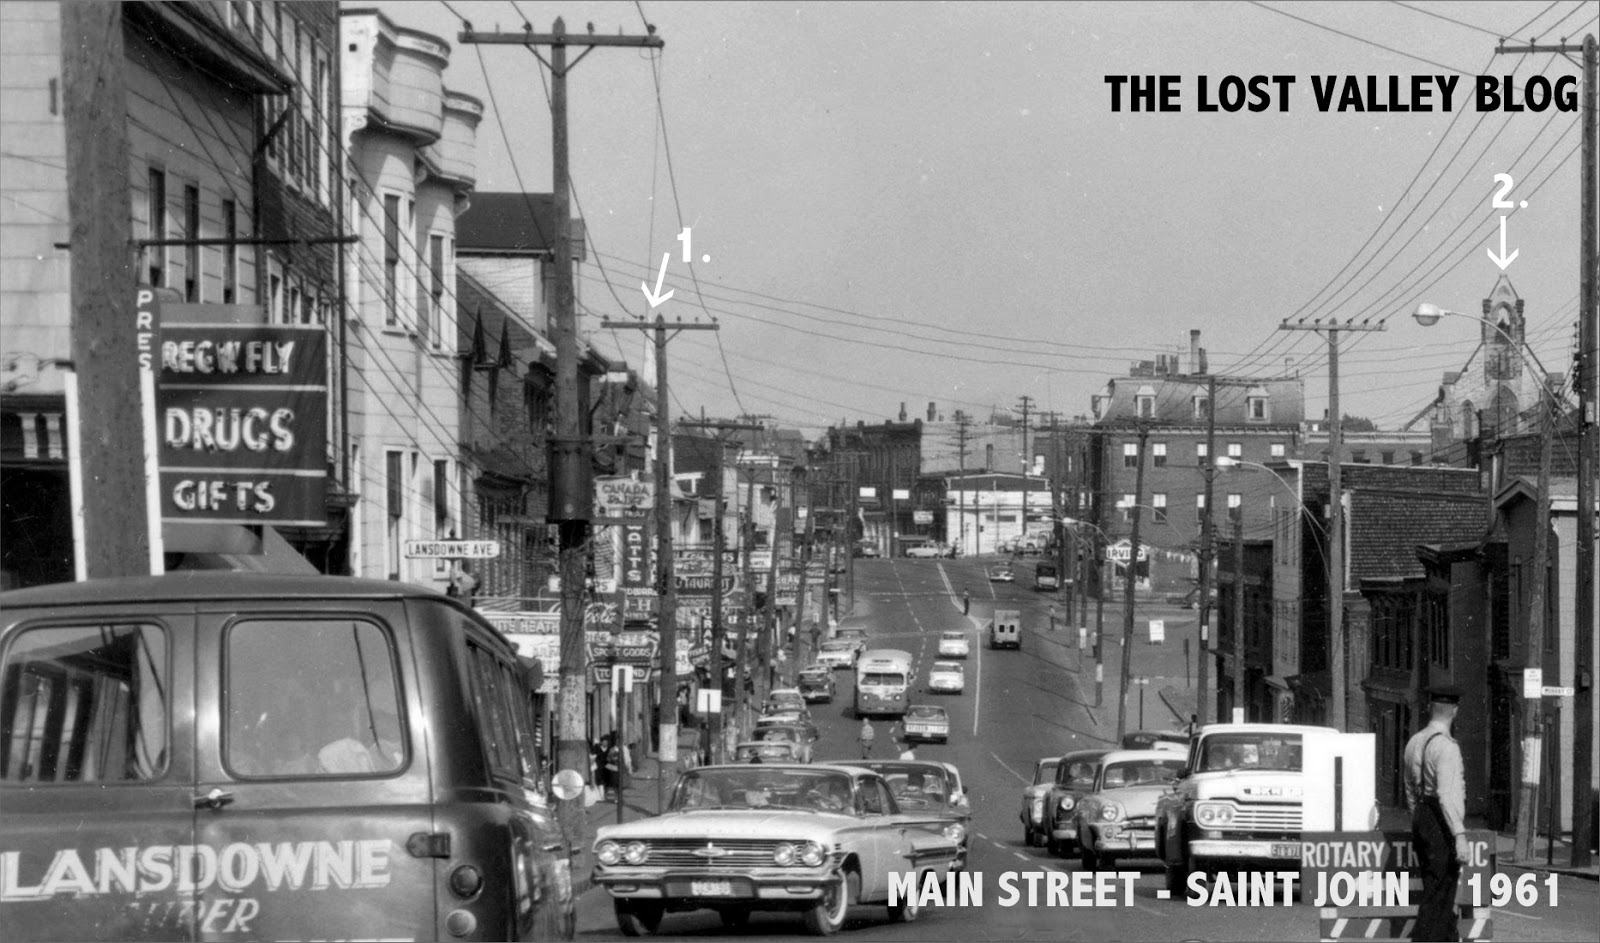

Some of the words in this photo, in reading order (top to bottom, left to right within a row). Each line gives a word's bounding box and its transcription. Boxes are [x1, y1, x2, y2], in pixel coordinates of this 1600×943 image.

[244, 341, 296, 374] FLY
[165, 407, 294, 452] DRUGS
[173, 480, 276, 513] GIFTS
[408, 543, 469, 557] LANSDOWNE
[473, 543, 493, 557] AVE
[1107, 548, 1144, 559] IRVIG
[593, 648, 621, 657] SPOT
[0, 838, 392, 900] LANSDOWNE
[1302, 841, 1386, 868] ROTARY
[1393, 842, 1488, 868] TRIC
